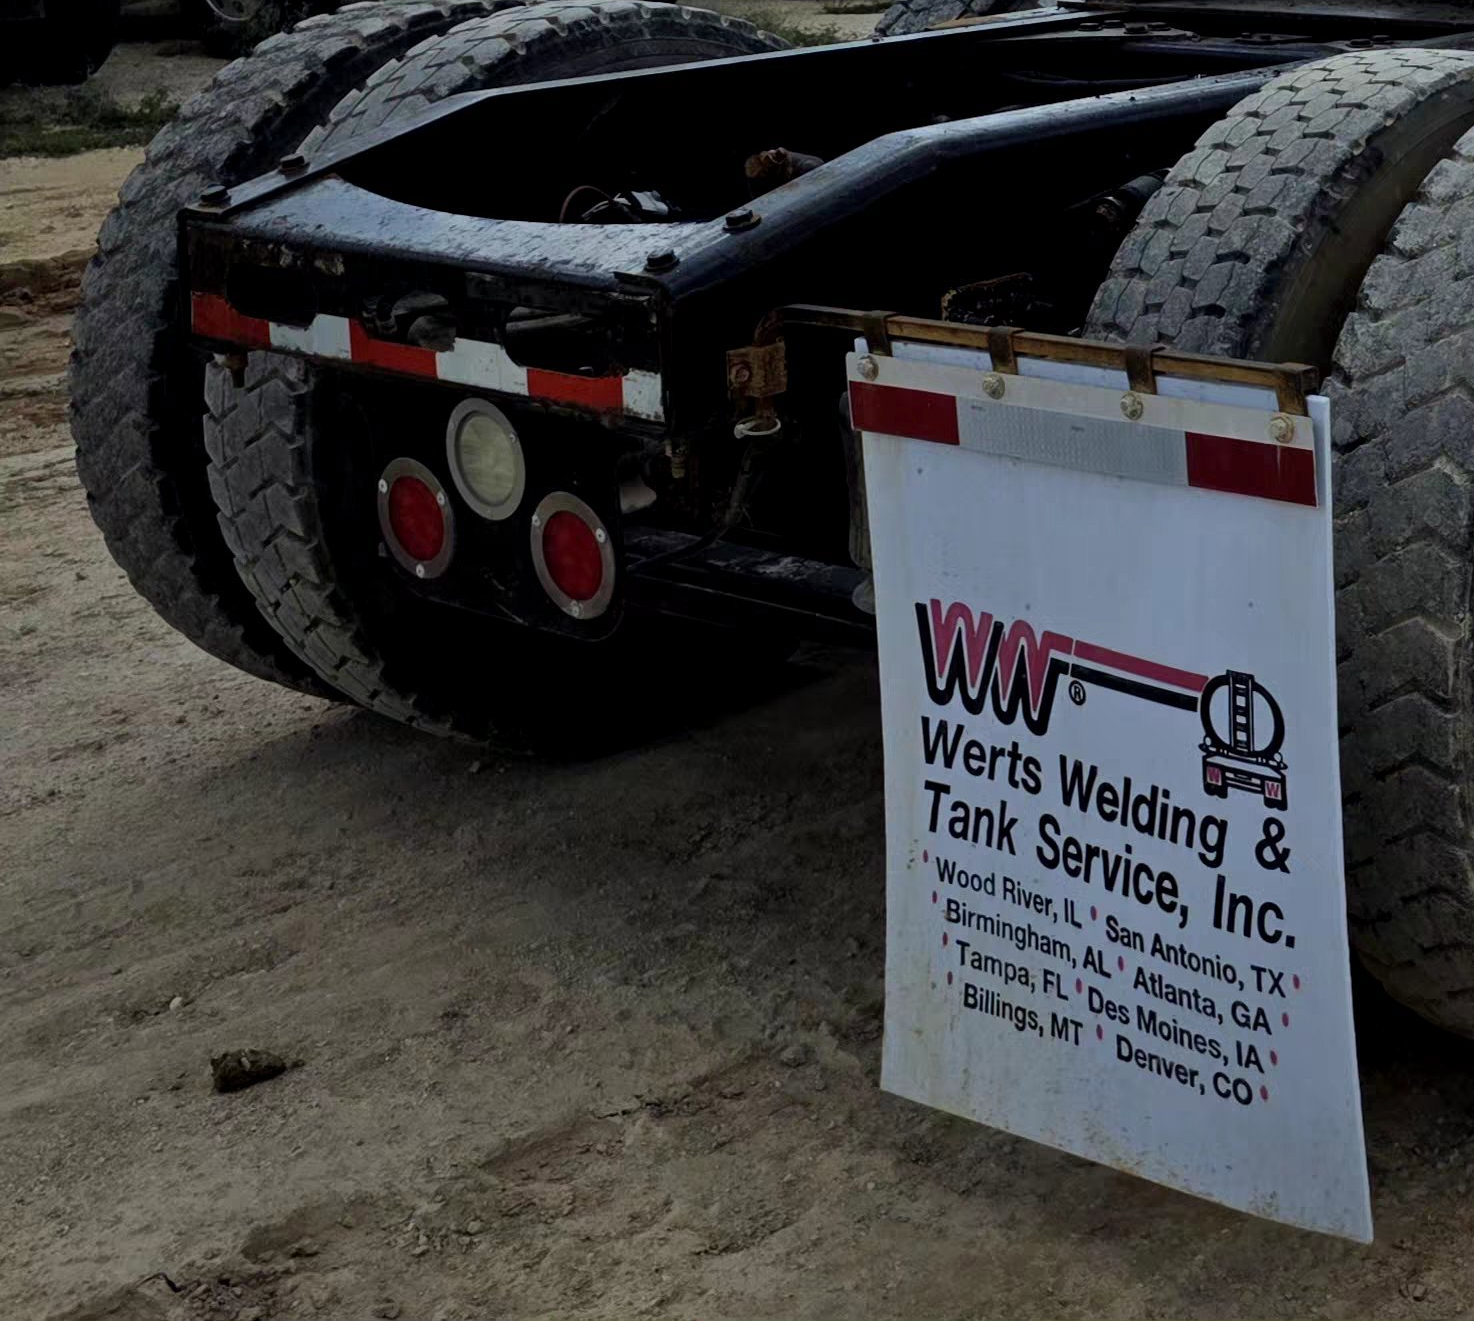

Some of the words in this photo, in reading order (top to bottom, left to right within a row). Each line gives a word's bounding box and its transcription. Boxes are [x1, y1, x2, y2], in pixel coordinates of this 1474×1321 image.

[921, 715, 1042, 795] Werts
[1059, 754, 1228, 868] Welding
[1254, 816, 1291, 874] &
[924, 780, 1019, 855] Tank
[1036, 813, 1188, 930] Service,
[1212, 873, 1296, 949] Inc.
[935, 856, 996, 897] Wood
[1002, 875, 1058, 924] River,
[1063, 897, 1083, 929] IL
[1105, 914, 1145, 954] San
[1149, 932, 1245, 992] Antonio,
[1249, 964, 1287, 999] TX
[945, 897, 1077, 970] Birmingham,
[1082, 945, 1112, 979] AL
[1132, 966, 1224, 1026] Atlanta,
[1230, 1000, 1273, 1036] GA
[955, 939, 1036, 994] Tampa,
[1042, 968, 1069, 1002] FL
[1087, 985, 1131, 1025] Des
[1136, 1004, 1229, 1067] Moines,
[1235, 1039, 1265, 1075] IA
[963, 982, 1044, 1038] Billings,
[1050, 1011, 1084, 1047] MT
[1115, 1033, 1206, 1096] Denver,
[1212, 1071, 1254, 1106] CO
